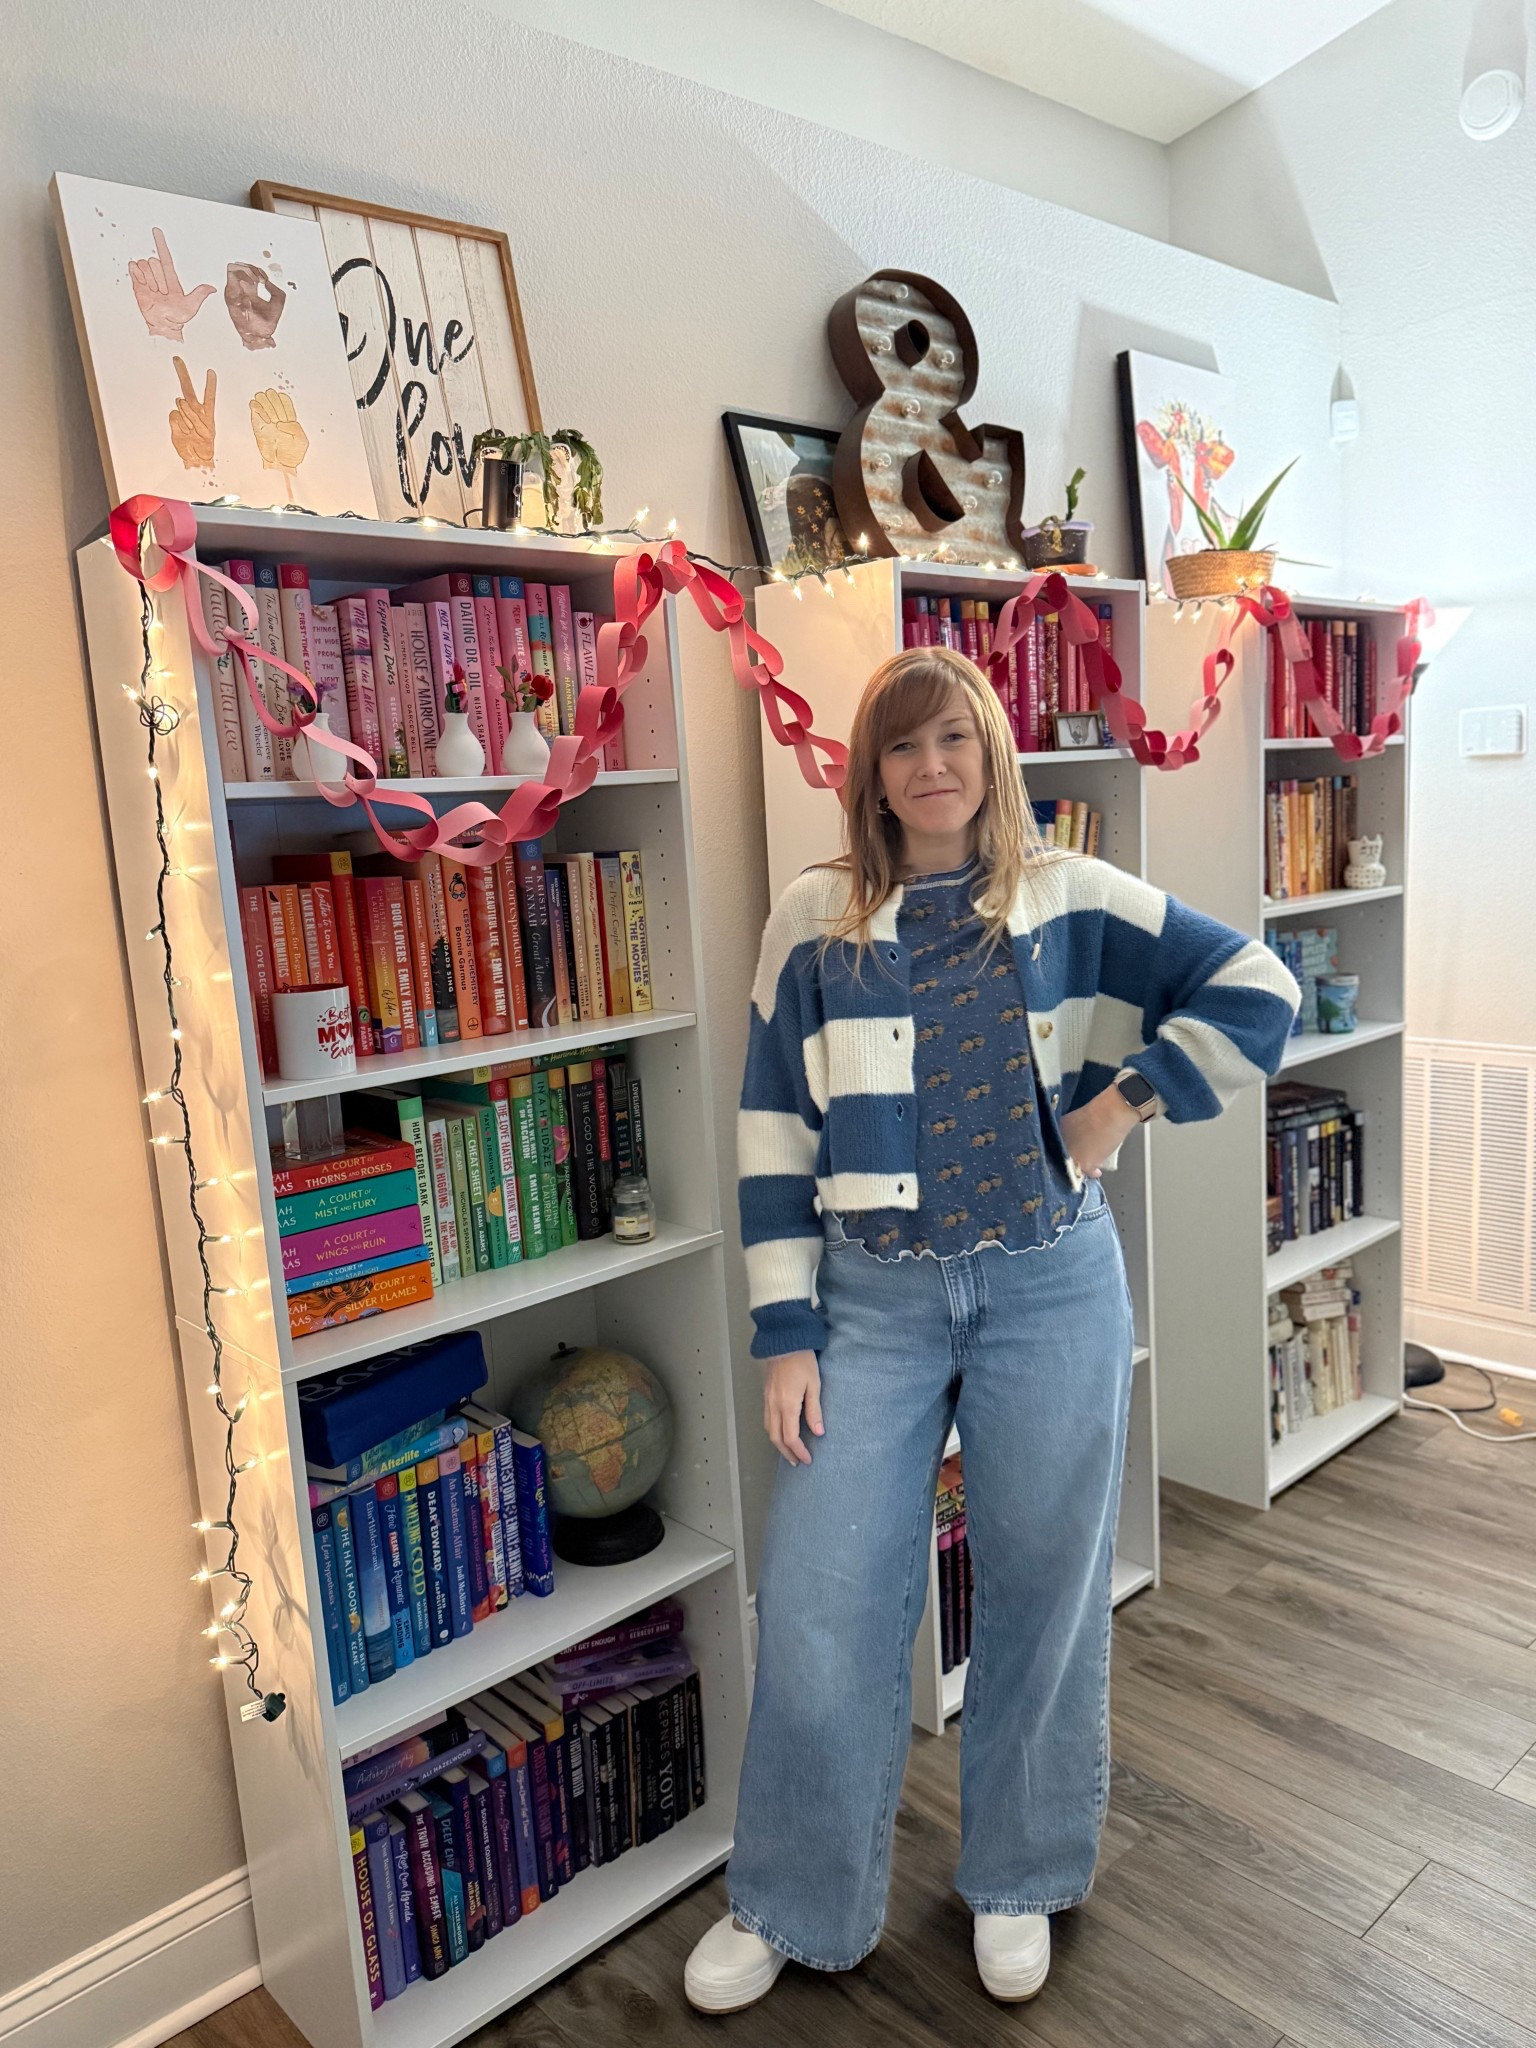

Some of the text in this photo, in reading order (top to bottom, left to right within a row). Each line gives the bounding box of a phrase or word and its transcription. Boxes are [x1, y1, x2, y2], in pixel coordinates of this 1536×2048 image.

[331, 258, 477, 411] One
[376, 599, 396, 686] Expiration Dates
[411, 630, 428, 671] HOUSE
[437, 609, 453, 666] NOT IN LOVE
[513, 604, 526, 657] RED WHITE
[209, 582, 238, 751] Jaded Ela Lee
[460, 602, 483, 720] DATING DR. DIL NISHA
[361, 686, 374, 714] Lake
[564, 676, 573, 711] HANNAH
[418, 686, 437, 752] MARIONNE
[285, 888, 300, 951] Happiness for
[302, 894, 315, 930] LAUREN
[370, 895, 380, 931] LAUREN
[376, 889, 387, 938] CHRISTINA
[525, 876, 538, 928] HANNAH
[537, 875, 548, 926] KRISTIN
[272, 918, 284, 936] DEAD
[314, 886, 335, 969] Loathe Love You
[505, 878, 523, 968] Correspondent
[637, 915, 648, 962] NOTHING
[249, 895, 270, 1023] THE LOVE DECEPTION
[390, 902, 415, 1030] BOOK LOVERS EMILY HENRY
[419, 942, 427, 967] WHEN
[455, 926, 467, 991] Bonnie Garmus
[462, 909, 479, 1006] LESSONS CHEMISTRY
[486, 893, 507, 1017] BEAUTIFUL LIFE EMILY HENRY
[532, 932, 544, 993] Great Alone
[629, 921, 642, 983] THE MOVIES
[422, 969, 429, 978] IN
[423, 981, 432, 1005] ROME
[447, 971, 455, 993] SING
[536, 1081, 545, 1094] IN
[465, 1122, 474, 1139] The
[632, 1082, 642, 1142] LOVELIGHT FARMS
[468, 1140, 479, 1167] CHEAT
[486, 1145, 495, 1175] JENKINS
[520, 1120, 531, 1159] VACATION
[582, 1100, 599, 1214] THE GOD OF THE WOODS
[305, 1162, 393, 1188] THORNS ROSES
[332, 1156, 367, 1170] COURT
[412, 1121, 433, 1239] HOME BEFORE DARK RILEY
[432, 1132, 449, 1209] KRISTAN HIGGINS
[471, 1170, 482, 1197] SHEET
[497, 1103, 520, 1241] THE LOVE HATERS KATHERINE CENTER
[314, 1197, 378, 1220] MIST FURY
[329, 1189, 363, 1205] COURT
[529, 1174, 543, 1236] EMILY HENRY
[541, 1185, 552, 1222] LAUREN
[550, 1176, 559, 1227] CHRISTINA
[334, 1229, 368, 1246] COURT
[459, 1191, 471, 1255] NICHOLAS SPARKS
[478, 1231, 486, 1252] ADAMS
[315, 1236, 386, 1263] WINGS RUIN
[442, 1236, 450, 1255] MOON
[335, 1264, 358, 1276] COURT
[374, 1276, 406, 1293] COURT
[345, 1285, 418, 1314] SILVER FLAMES
[380, 1449, 420, 1473] Afterlife
[448, 1478, 457, 1490] An
[463, 1472, 472, 1497] LOVE
[449, 1491, 460, 1533] Academic
[499, 1437, 523, 1580] FUNNY STORY EMILY HENRY
[389, 1531, 401, 1568] FREAKING
[427, 1490, 442, 1572] DEAR EDWARD
[453, 1535, 461, 1559] Affair
[340, 1527, 358, 1616] THE HALF MOON
[411, 1546, 426, 1596] COLD
[457, 1582, 466, 1616] McAlister
[351, 1641, 359, 1666] KEANE
[578, 1641, 590, 1650] GET
[591, 1635, 616, 1647] ENOUGH
[658, 1699, 671, 1761] KEPNES
[422, 1748, 472, 1779] ALI HAZELWOOD
[533, 1745, 545, 1782] CROSS
[659, 1761, 674, 1811] YOU
[441, 1819, 455, 1868] DEEP END
[480, 1808, 493, 1881] SOULMATE EQUATION
[416, 1826, 443, 1921] TRUTH ACCORDING EMBER
[356, 1855, 381, 1983] HOUSE OF GLASS
[400, 1890, 414, 1923] Agenda
[467, 1881, 476, 1917] MIRANDA
